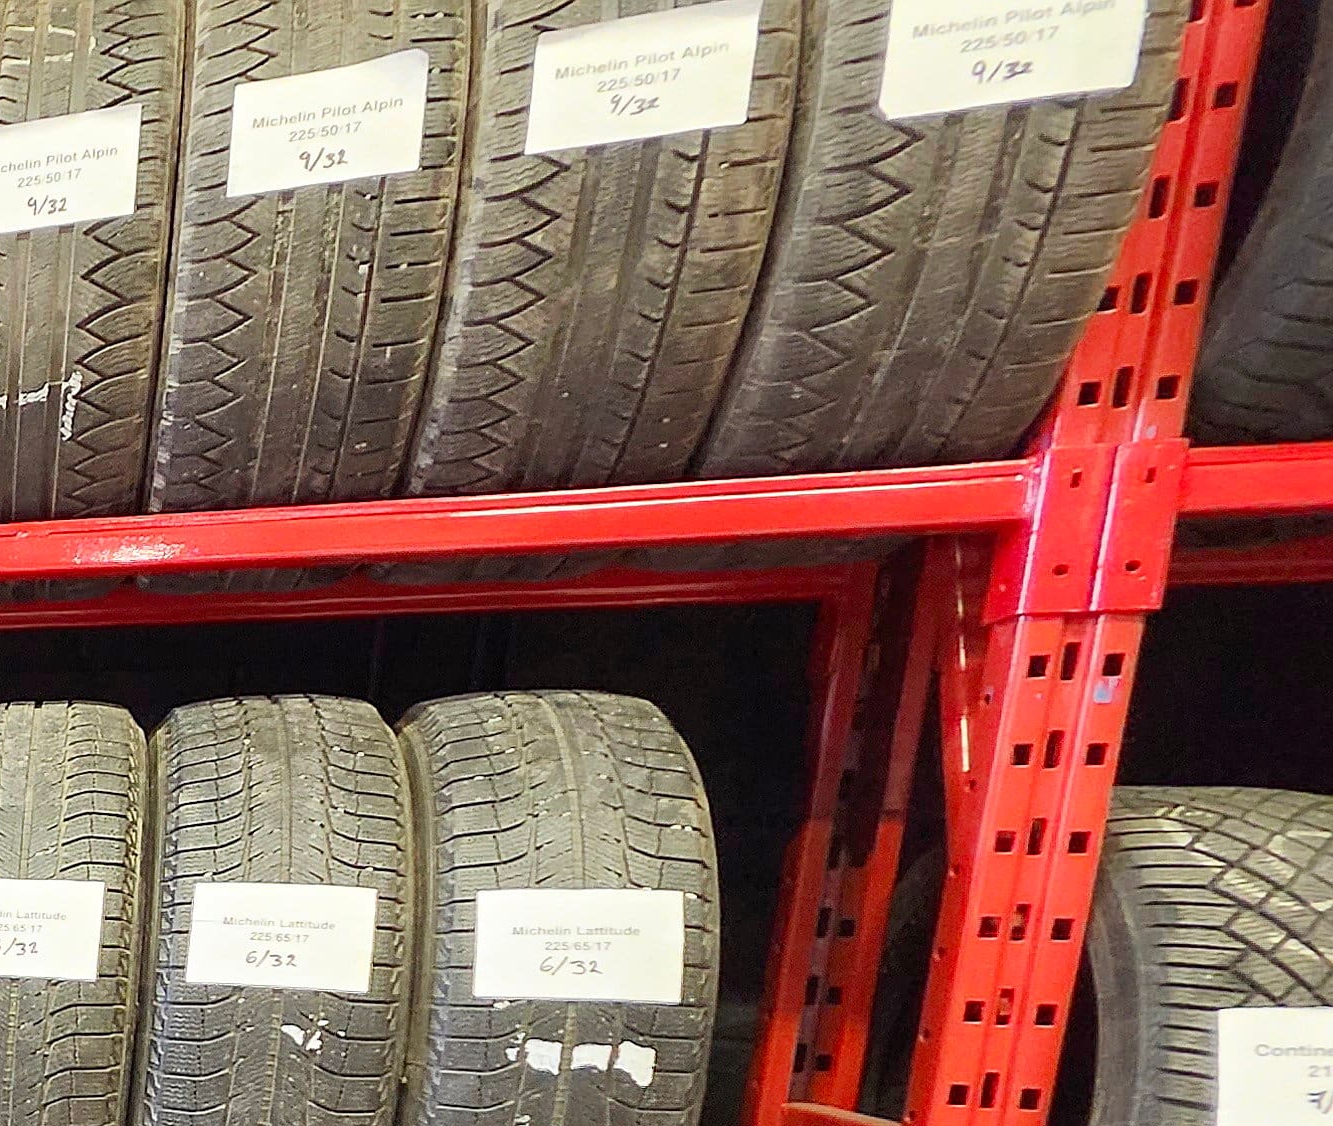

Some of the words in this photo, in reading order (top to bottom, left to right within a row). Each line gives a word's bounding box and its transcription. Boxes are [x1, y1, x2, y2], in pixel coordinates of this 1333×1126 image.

[912, 14, 998, 39] Michelin
[1004, 6, 1054, 25] Pilot
[555, 58, 628, 80] Michelin
[634, 50, 676, 67] Pilot
[682, 41, 730, 60] Alpin
[971, 59, 1034, 84] 9/32
[252, 111, 316, 129] Michelin
[321, 104, 357, 118] Pilot
[362, 97, 403, 114] Alpin
[610, 94, 660, 116] 9/32
[46, 152, 78, 167] Pilot
[81, 145, 118, 162] Alpin
[298, 147, 348, 172] 9/32
[27, 196, 68, 216] 9/32
[223, 916, 275, 928] Michelin
[511, 925, 572, 937] Michelin
[245, 950, 297, 967] 6/32
[539, 956, 604, 976] 6/32
